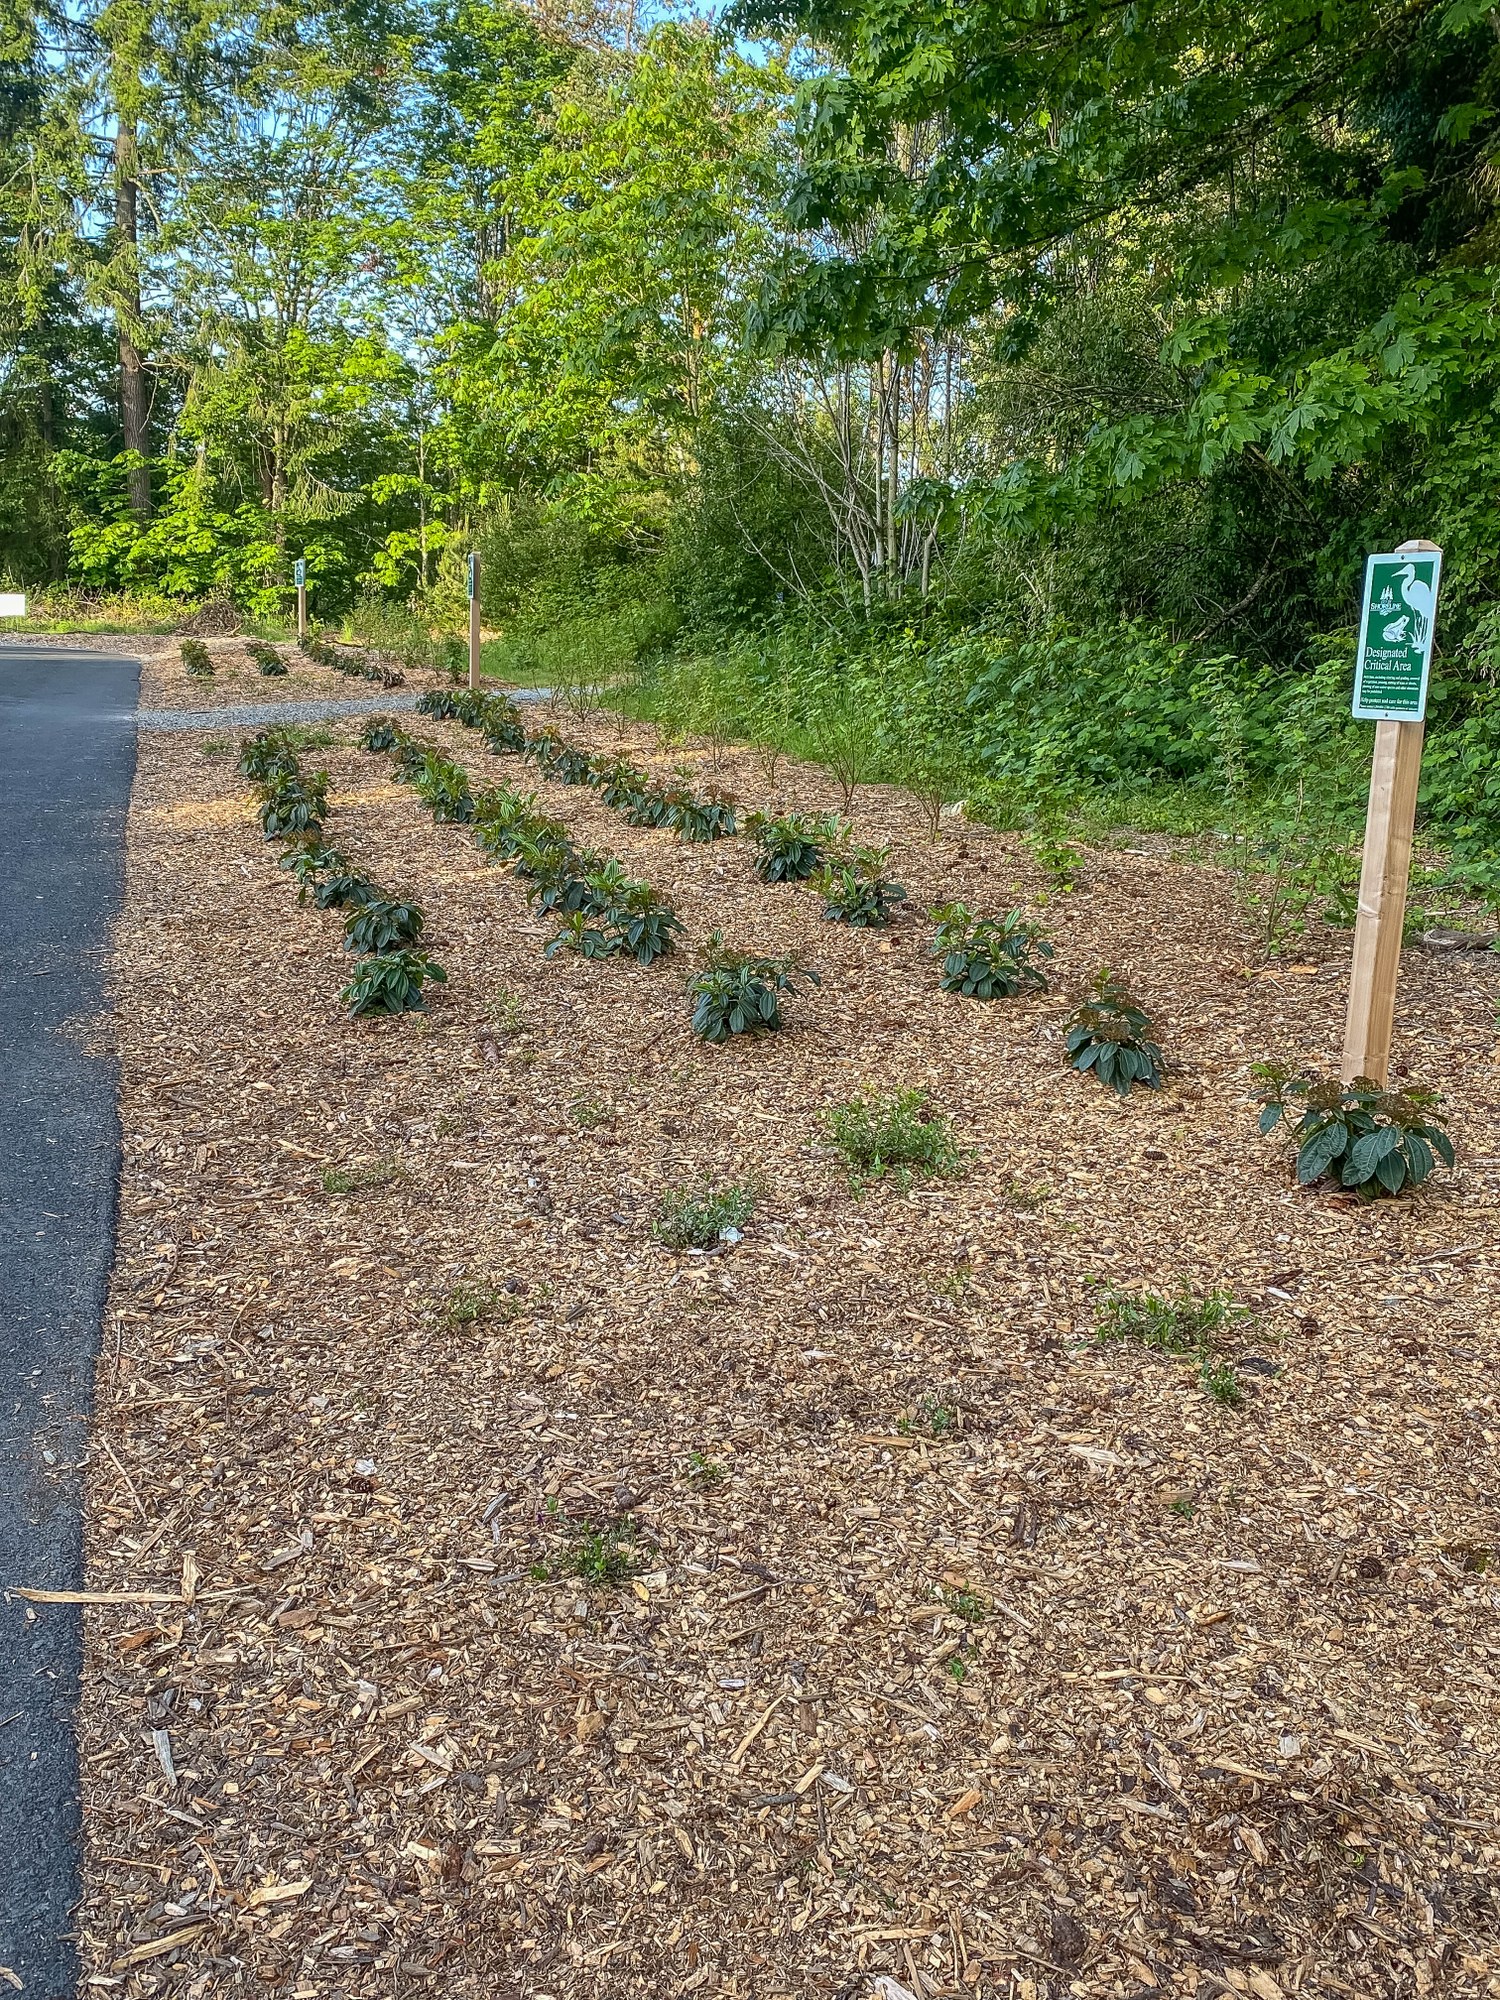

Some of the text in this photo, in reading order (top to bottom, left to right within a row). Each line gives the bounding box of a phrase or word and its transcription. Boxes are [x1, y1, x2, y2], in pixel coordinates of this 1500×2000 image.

[1366, 646, 1408, 660] Designated
[1364, 660, 1412, 671] Critical Area
